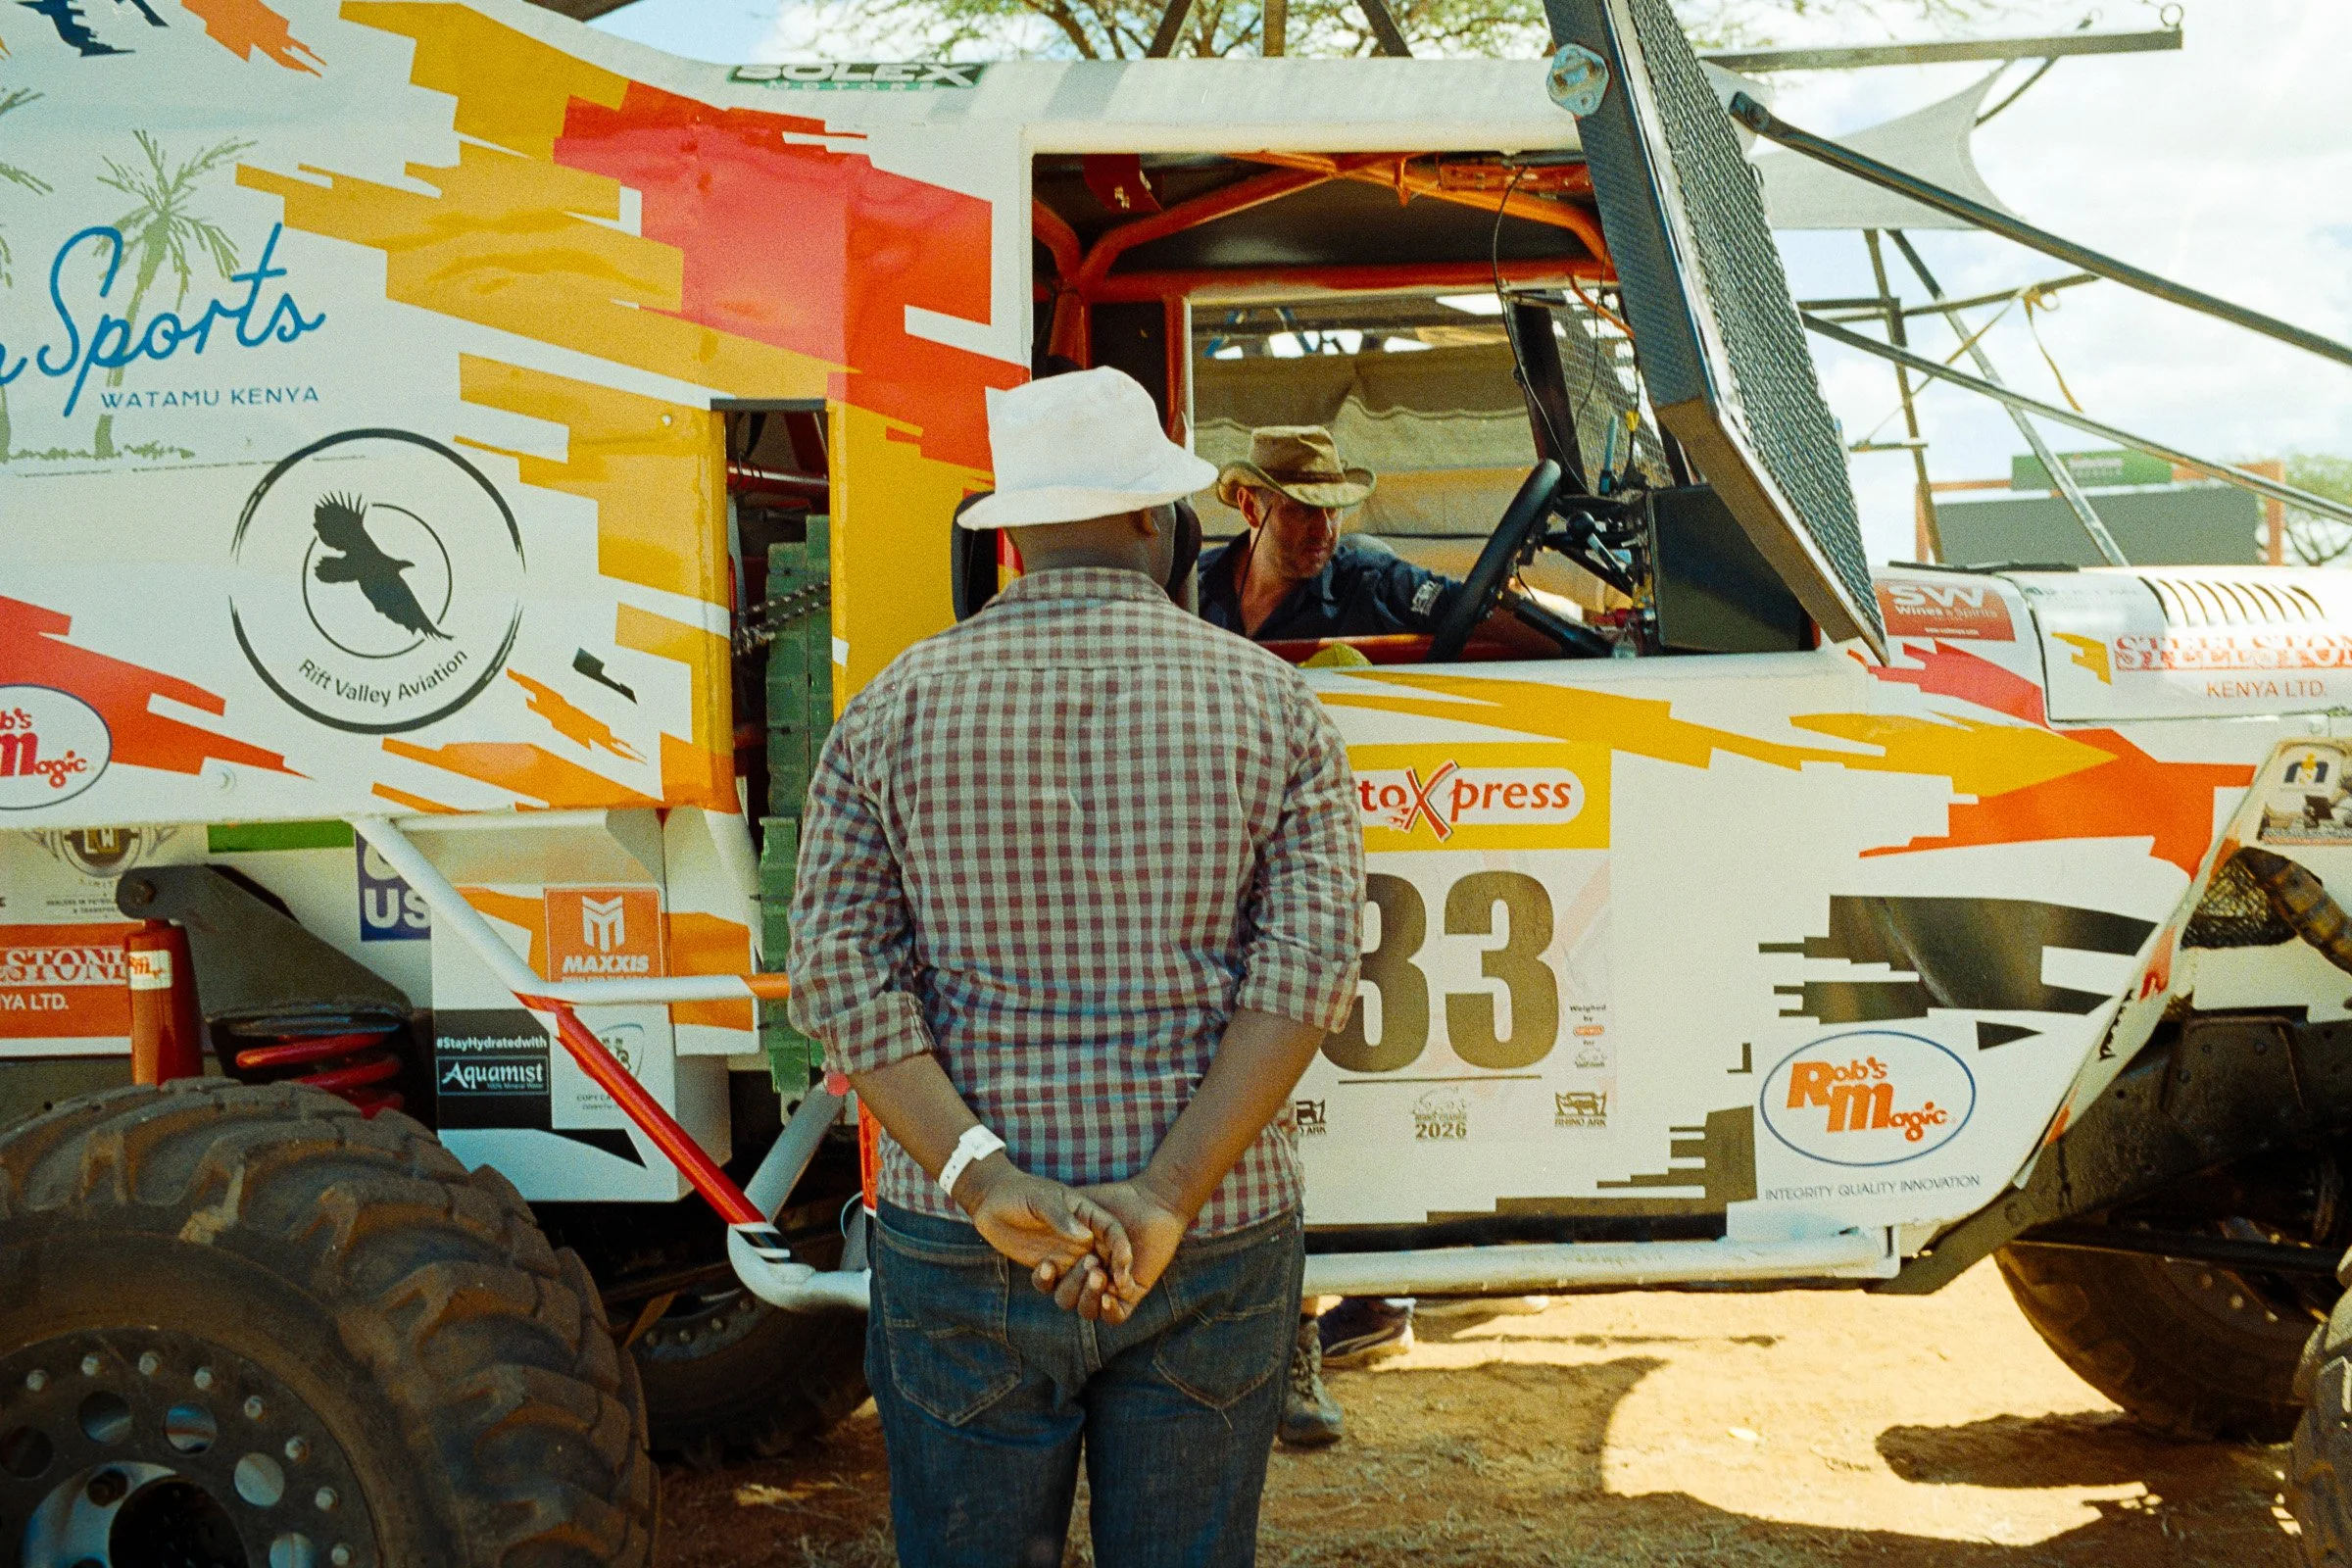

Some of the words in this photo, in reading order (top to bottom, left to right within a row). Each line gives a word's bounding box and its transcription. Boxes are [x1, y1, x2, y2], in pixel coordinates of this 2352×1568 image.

[735, 63, 977, 88] SOLEX
[36, 221, 326, 418] Sports
[101, 388, 220, 409] WATAMU
[231, 386, 319, 406] KENYA
[1887, 584, 1984, 609] SW
[298, 658, 333, 691] Rift
[335, 677, 392, 708] Valley
[398, 650, 468, 701] Aviation
[2206, 681, 2278, 699] KENYA
[2285, 680, 2327, 698] LTD.
[0, 949, 127, 981] STON
[562, 954, 650, 973] MAXXIS
[1320, 870, 1560, 1073] 33
[29, 992, 70, 1010] LTD.
[436, 1035, 548, 1053] #StayHydratedwith
[440, 1060, 544, 1090] Aquamist
[1786, 1054, 1888, 1109] Rob's
[1826, 1081, 1949, 1142] Magic
[1415, 1123, 1467, 1140] 2026
[1838, 1180, 1896, 1198] QUALITY
[1899, 1172, 1982, 1193] INNOVATION
